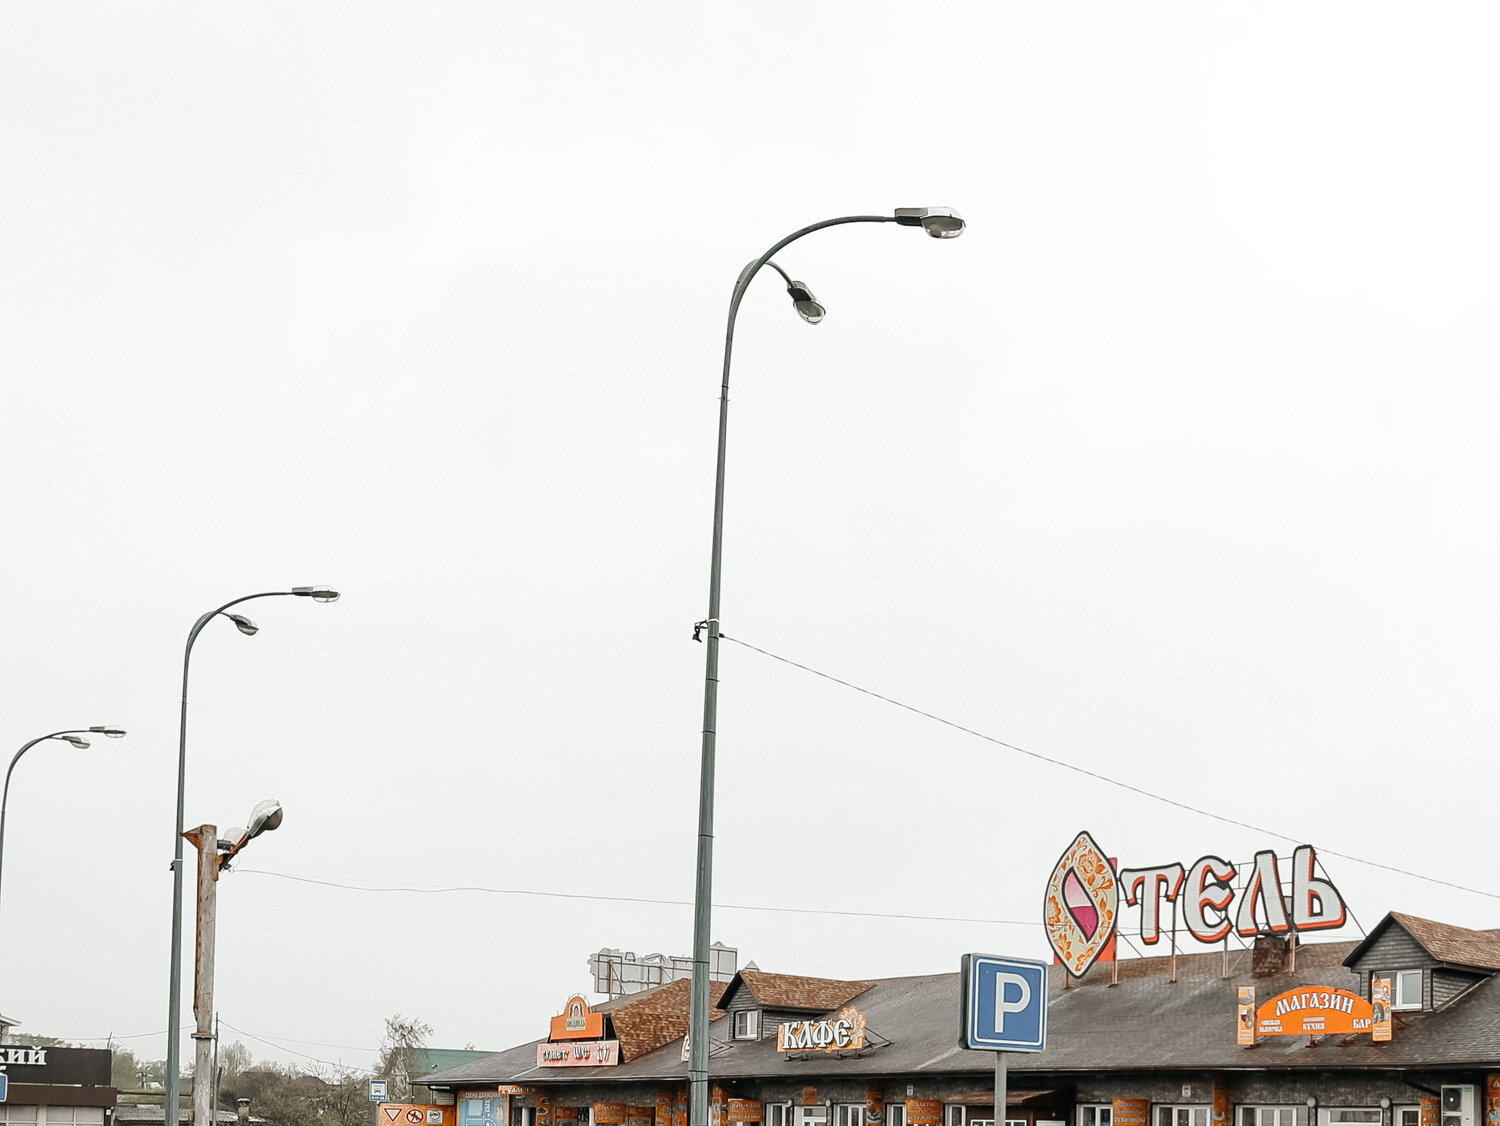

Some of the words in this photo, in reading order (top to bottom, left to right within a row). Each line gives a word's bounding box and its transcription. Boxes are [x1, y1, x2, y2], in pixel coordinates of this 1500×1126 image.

[1043, 831, 1346, 979] ОТЕЛЬ
[994, 971, 1032, 1033] P
[1275, 992, 1355, 1016] МАГАЗИН
[782, 1019, 852, 1049] КАФЕ
[1352, 1018, 1372, 1029] БАР
